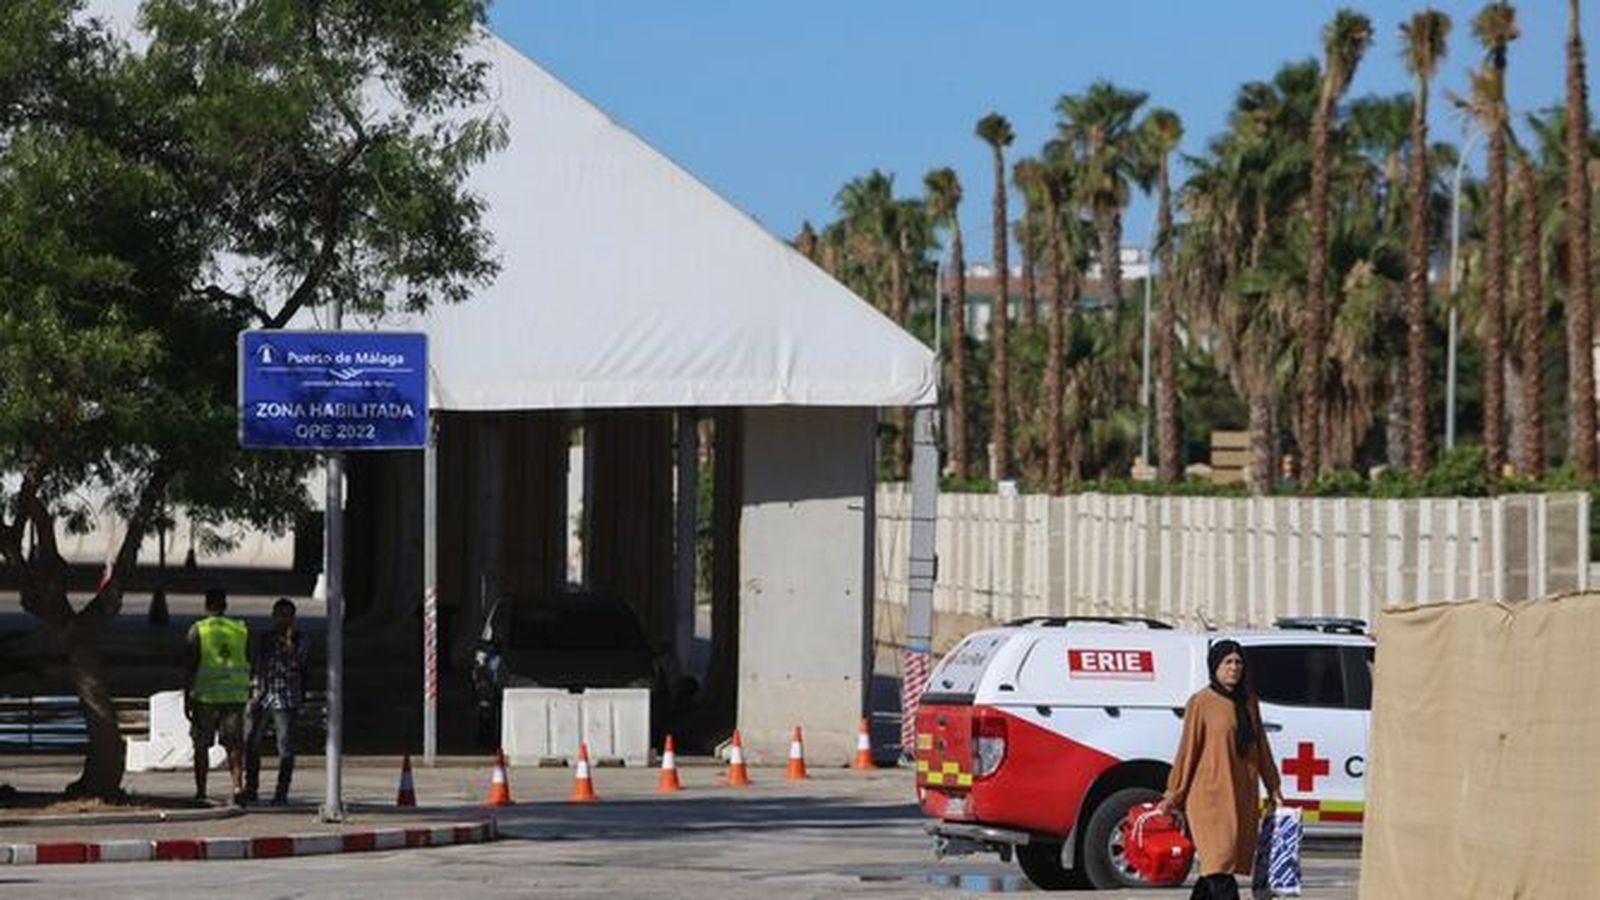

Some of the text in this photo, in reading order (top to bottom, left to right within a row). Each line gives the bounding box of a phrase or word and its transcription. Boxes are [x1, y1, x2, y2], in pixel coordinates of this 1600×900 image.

[287, 350, 404, 367] Puerto de Málaga
[256, 403, 414, 418] ZONA HABILITADA
[295, 424, 376, 438] OPE 2022
[1081, 652, 1142, 671] ERIE
